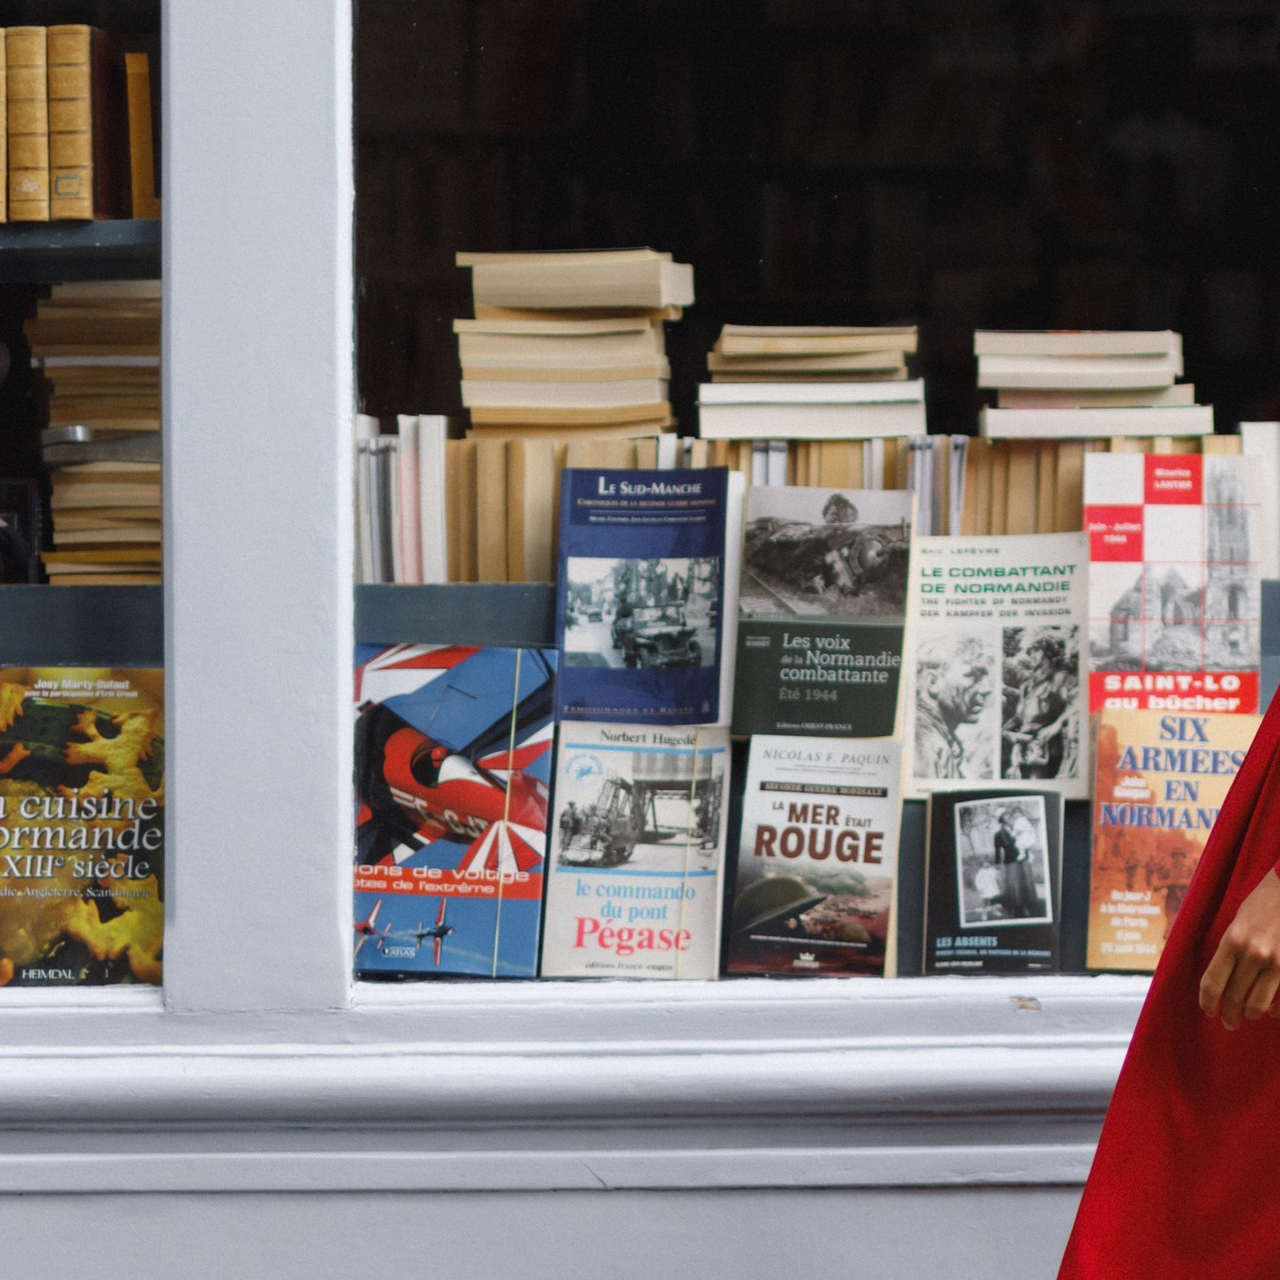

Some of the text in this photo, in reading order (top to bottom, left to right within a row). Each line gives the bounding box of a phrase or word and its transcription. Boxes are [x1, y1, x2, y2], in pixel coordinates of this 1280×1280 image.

[920, 564, 1078, 578] LE COMBATTANT
[920, 580, 1072, 594] DE NORMANDIE
[920, 597, 939, 605] THE
[945, 597, 987, 605] FIGHTER
[992, 597, 1004, 605] OF
[999, 609, 1018, 617] DER
[1025, 607, 1072, 617] INVASION
[782, 632, 851, 649] Les voix
[780, 653, 795, 664] de
[806, 650, 901, 666] Normandie
[779, 666, 890, 683] combattante
[778, 686, 838, 702] Été 1944
[601, 729, 647, 745] Norbert
[1158, 715, 1210, 743] SIX
[762, 748, 821, 762] NICOLAS
[840, 752, 892, 766] PAQUIN
[1164, 779, 1199, 802] EN
[19, 787, 158, 820] cuisine
[772, 801, 873, 829] LA MER ÉTAIT
[1099, 802, 1222, 829] NORMAN
[754, 824, 885, 864] ROUGE
[3, 853, 150, 879] XIIIe siècle
[412, 864, 442, 879] de
[452, 868, 530, 885] voltige
[392, 880, 414, 891] de
[418, 880, 495, 894] l'extrême
[575, 878, 697, 900] le commando
[600, 900, 669, 923] du pont
[573, 916, 692, 956] Pégase
[936, 935, 999, 948] LES ABSENTS
[390, 948, 416, 957] ATLAS
[22, 968, 75, 980] HEIMDAL
